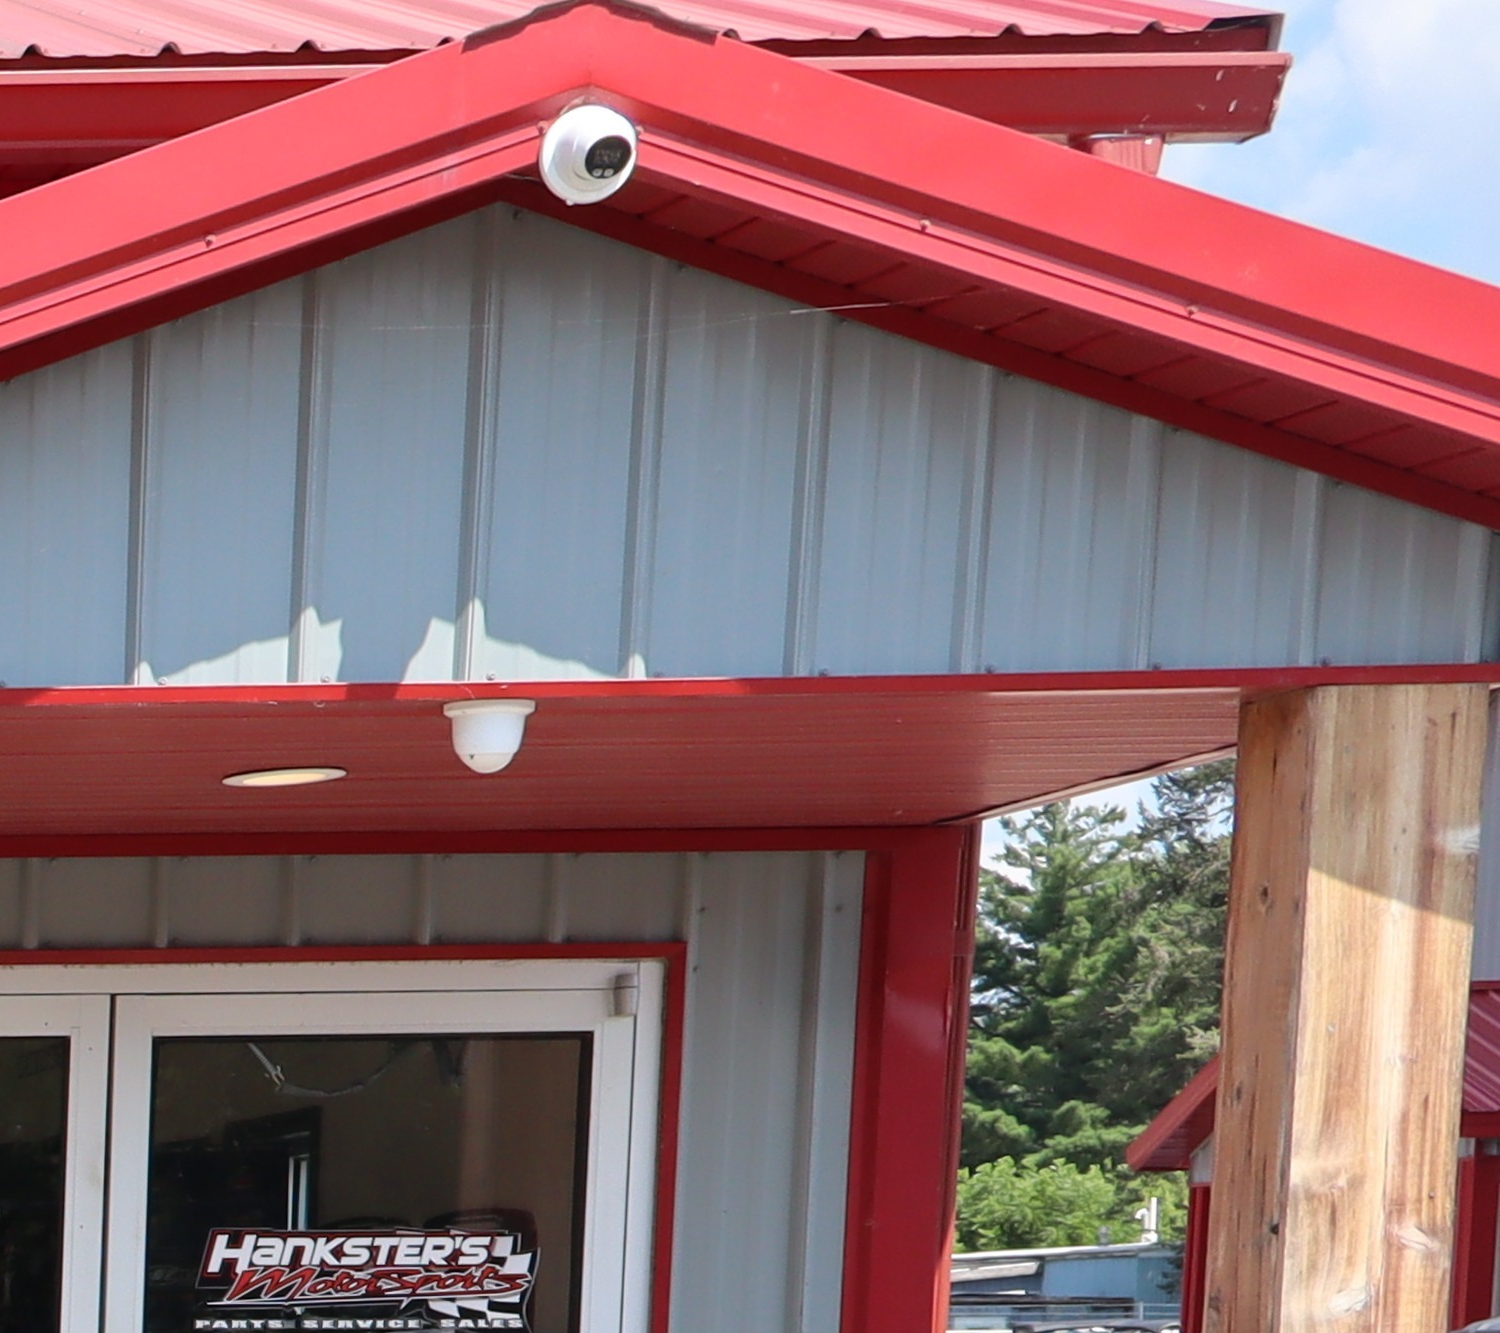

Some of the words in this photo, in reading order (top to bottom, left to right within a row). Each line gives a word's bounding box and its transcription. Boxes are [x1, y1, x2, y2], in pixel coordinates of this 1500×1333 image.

[195, 1319, 283, 1330] PARTS
[303, 1319, 425, 1330] SERVICE
[440, 1319, 524, 1330] SALES
